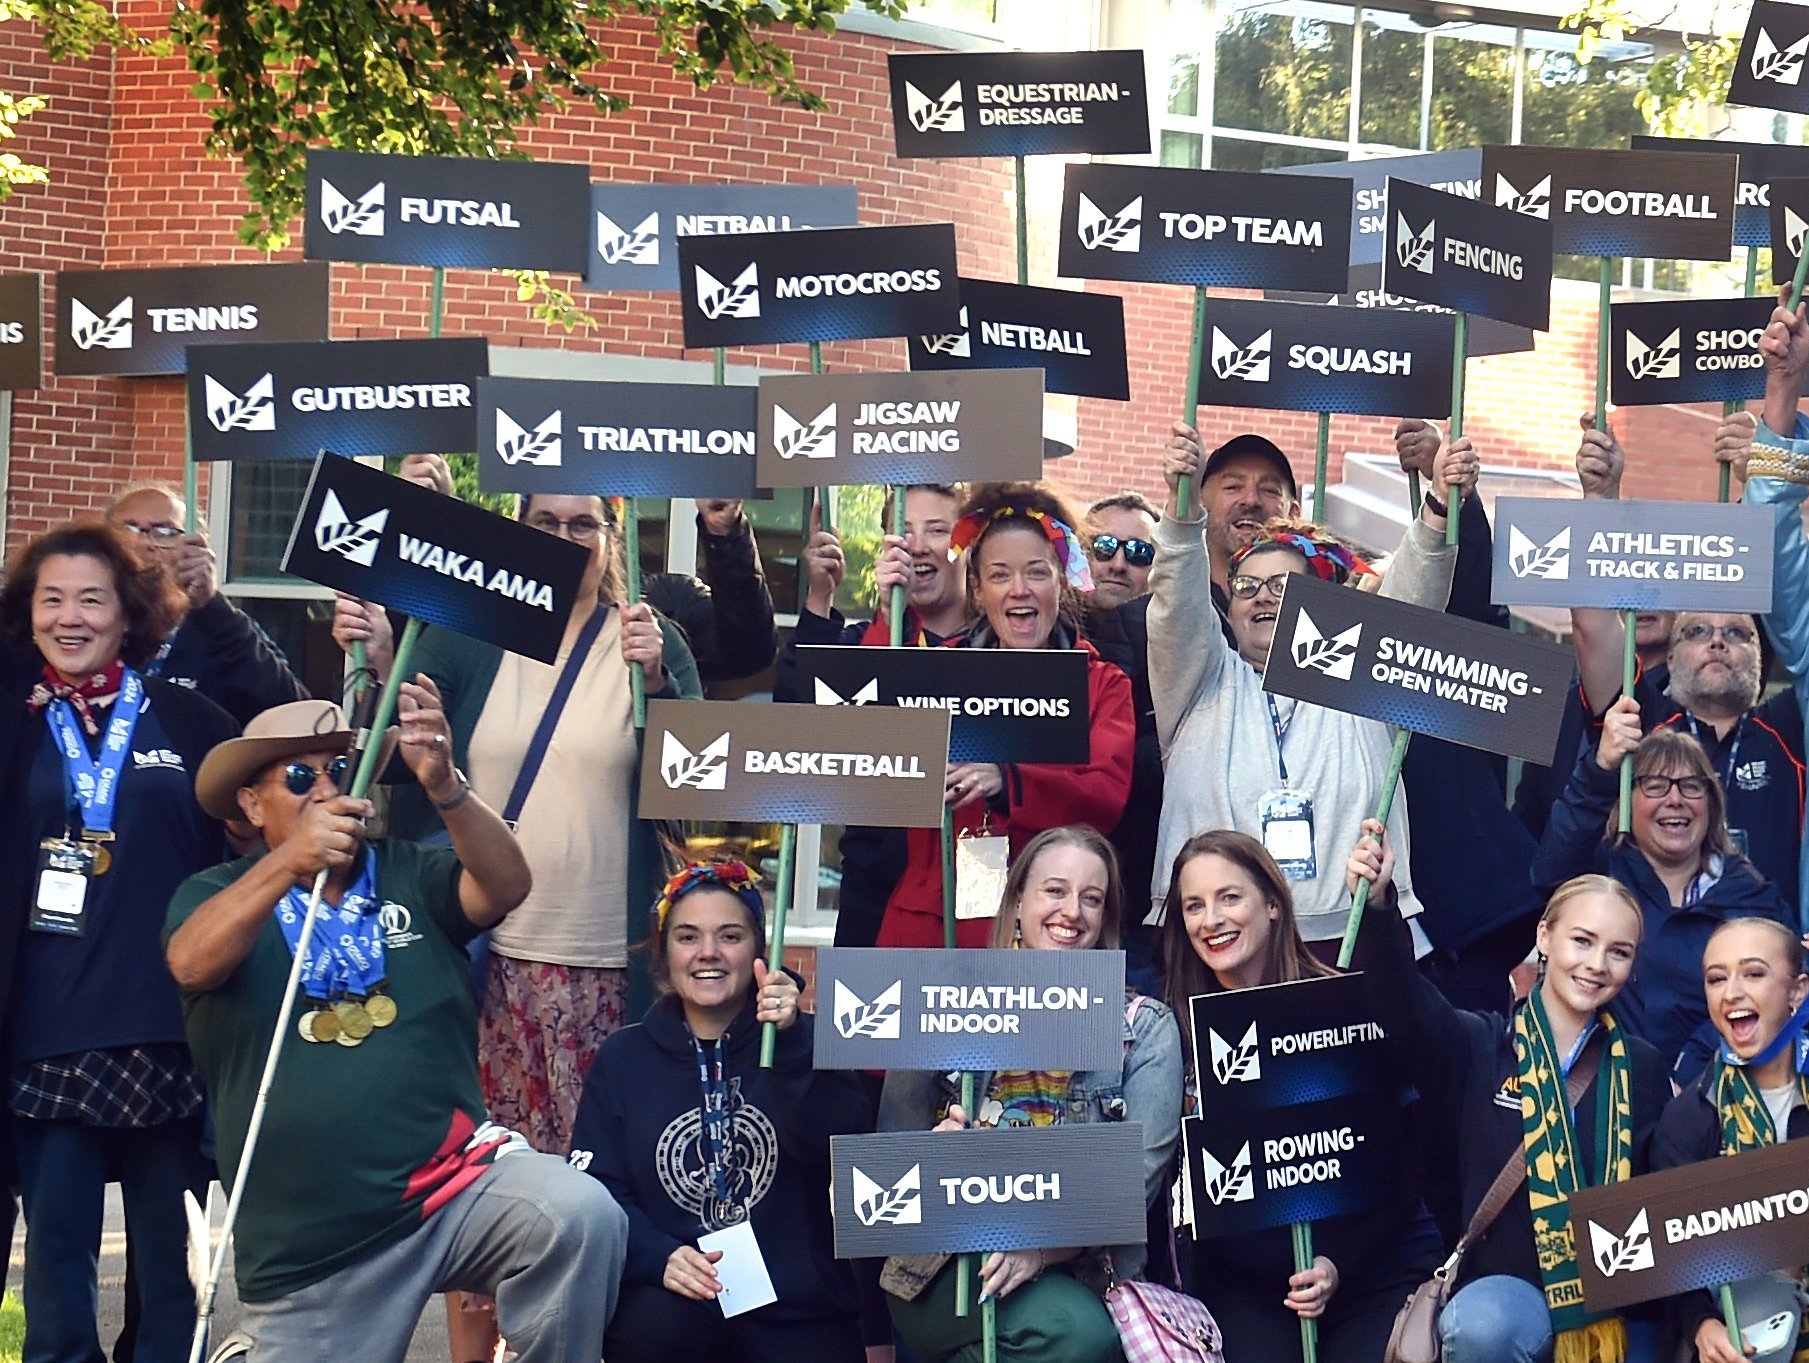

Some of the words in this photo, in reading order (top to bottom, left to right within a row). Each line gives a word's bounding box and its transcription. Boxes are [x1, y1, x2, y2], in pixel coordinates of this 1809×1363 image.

[979, 107, 1083, 125] DRESSAGE
[401, 198, 520, 227] FUTSAL
[1565, 190, 1717, 218] FOOTBALL
[1159, 213, 1226, 240] TOP
[1232, 217, 1322, 246] TEAM
[1444, 238, 1522, 280] FENCING
[776, 269, 940, 298] MOTOCROSS
[147, 305, 257, 332] TENNIS
[981, 321, 1091, 355] NETBALL
[1288, 345, 1411, 375] SQUASH
[1695, 353, 1764, 371] COWBO
[292, 384, 471, 411] GUTBUSTER
[853, 401, 960, 425] JIGSAW
[578, 427, 755, 454] TRIATHLON
[853, 430, 959, 454] RACING
[400, 535, 483, 587] WAKA
[486, 570, 555, 611] AMA
[1586, 560, 1660, 578] TRACK
[1664, 562, 1679, 579] &
[1683, 563, 1743, 581] FIELD
[1372, 664, 1431, 693] OPEN
[1436, 679, 1507, 713] WATER
[964, 698, 1069, 716] OPTIONS
[745, 751, 925, 778] BASKETBALL
[921, 1014, 1019, 1033] INDOOR
[1271, 1022, 1384, 1056] POWERLIFTIN
[1267, 1159, 1341, 1189] INDOOR
[940, 1173, 1060, 1204] TOUCH
